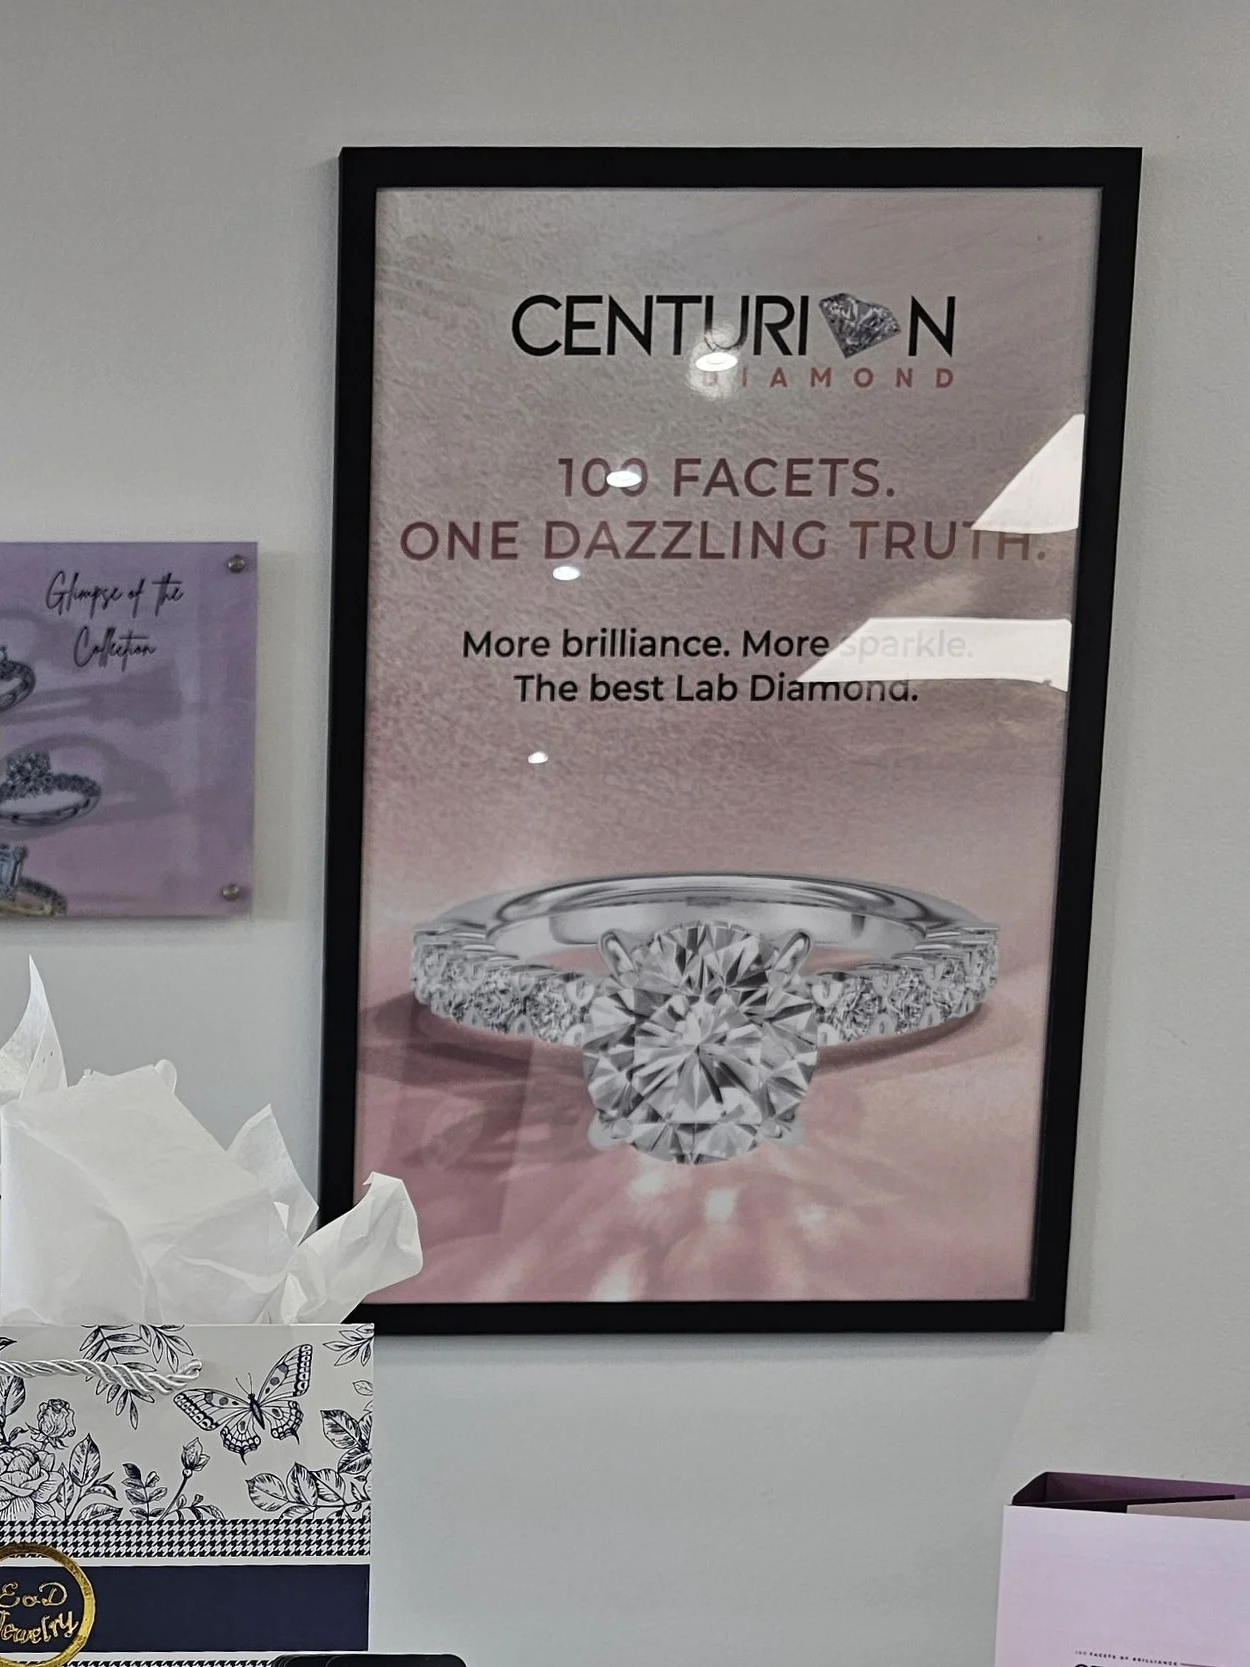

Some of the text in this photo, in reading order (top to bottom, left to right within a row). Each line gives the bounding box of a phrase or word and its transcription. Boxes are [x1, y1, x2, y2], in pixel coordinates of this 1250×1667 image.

[672, 457, 896, 498] FACETS.
[399, 520, 1047, 562] ONE DAZZLING TRUTH.
[127, 576, 146, 619] of
[462, 630, 551, 659] More
[561, 627, 731, 659] brilliance.
[741, 630, 830, 658] More
[514, 672, 919, 702] The best Lab Diamond.
